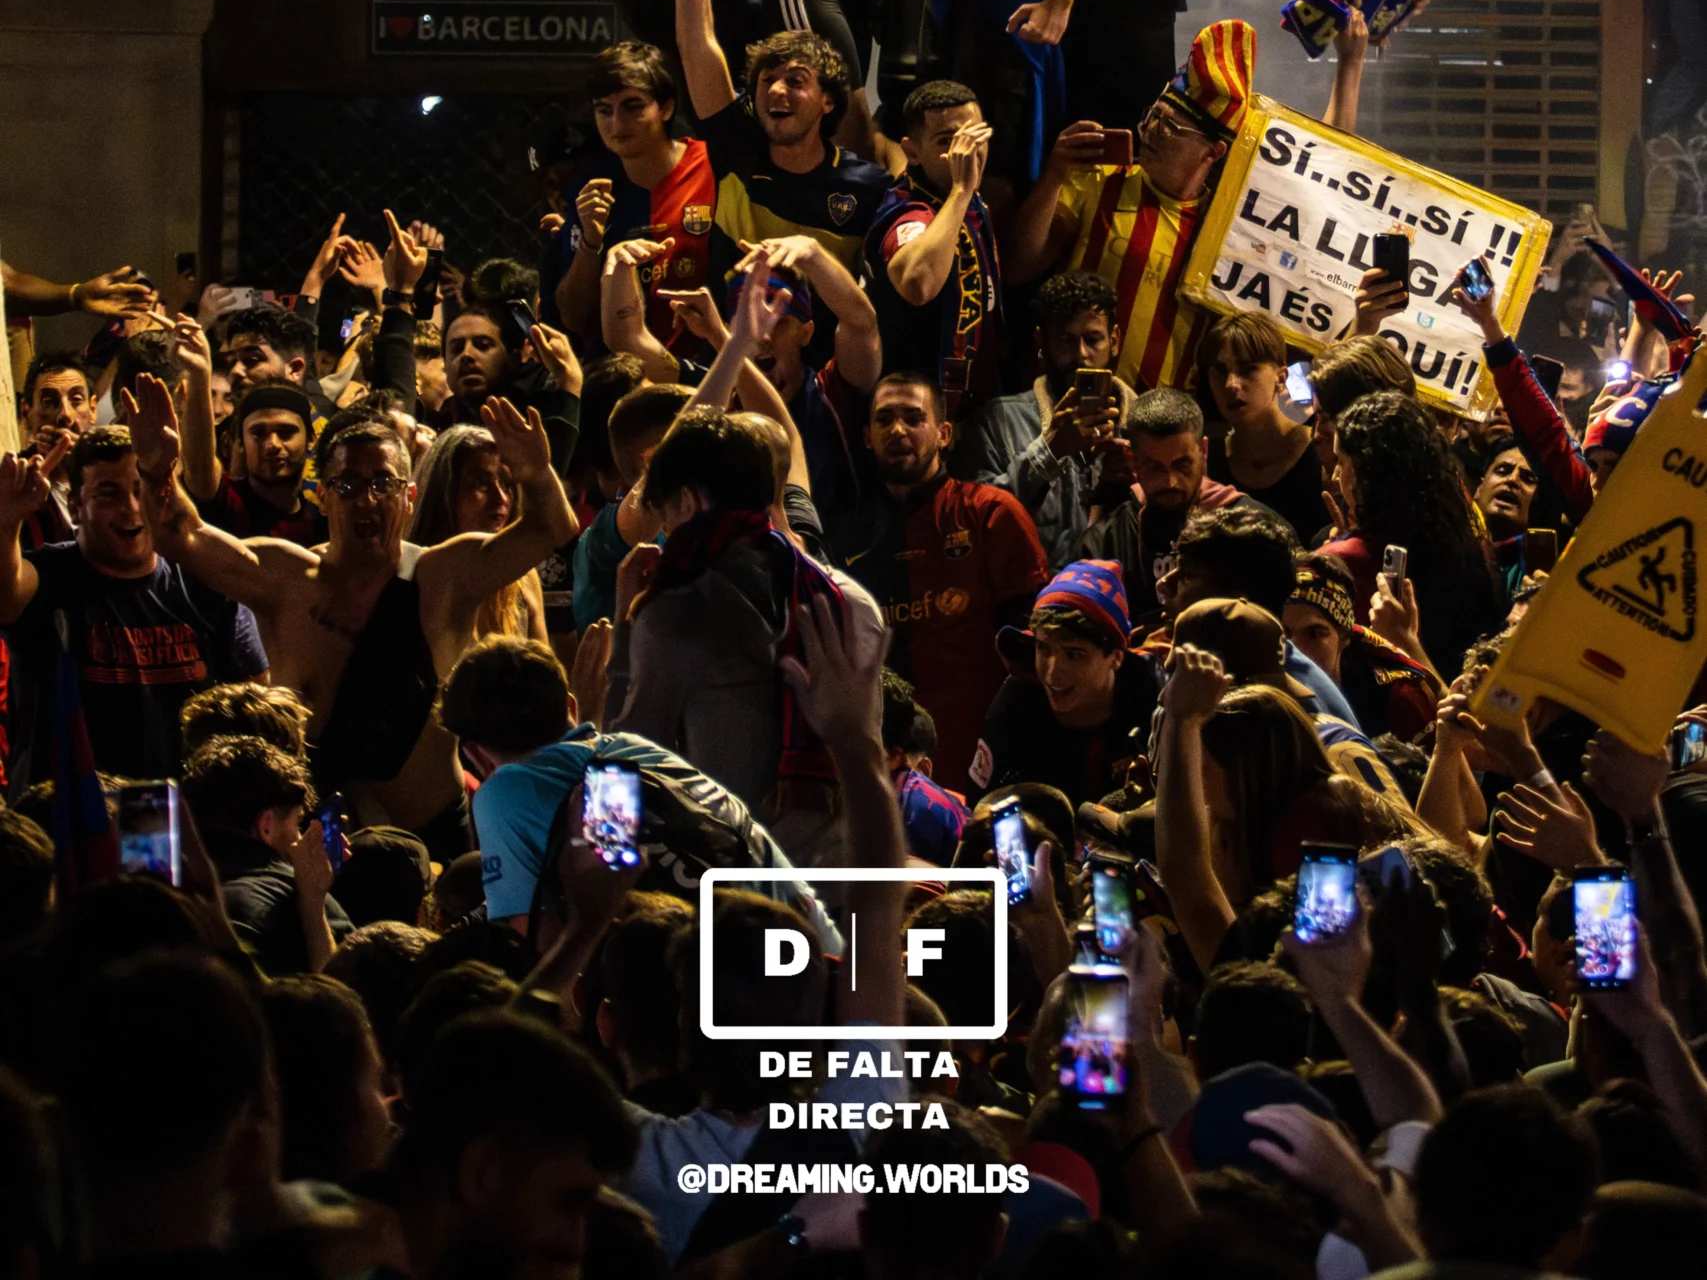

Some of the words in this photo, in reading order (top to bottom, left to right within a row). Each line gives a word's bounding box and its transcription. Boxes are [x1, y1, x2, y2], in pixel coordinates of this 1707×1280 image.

[378, 16, 387, 39] I
[416, 15, 612, 42] BARCELONA
[1240, 188, 1300, 242] LA
[1315, 217, 1471, 318] LLGA
[641, 258, 669, 283] cef
[1310, 268, 1358, 293] www.elbarr
[1662, 447, 1707, 488] CAU
[1595, 528, 1661, 570] CAUTION
